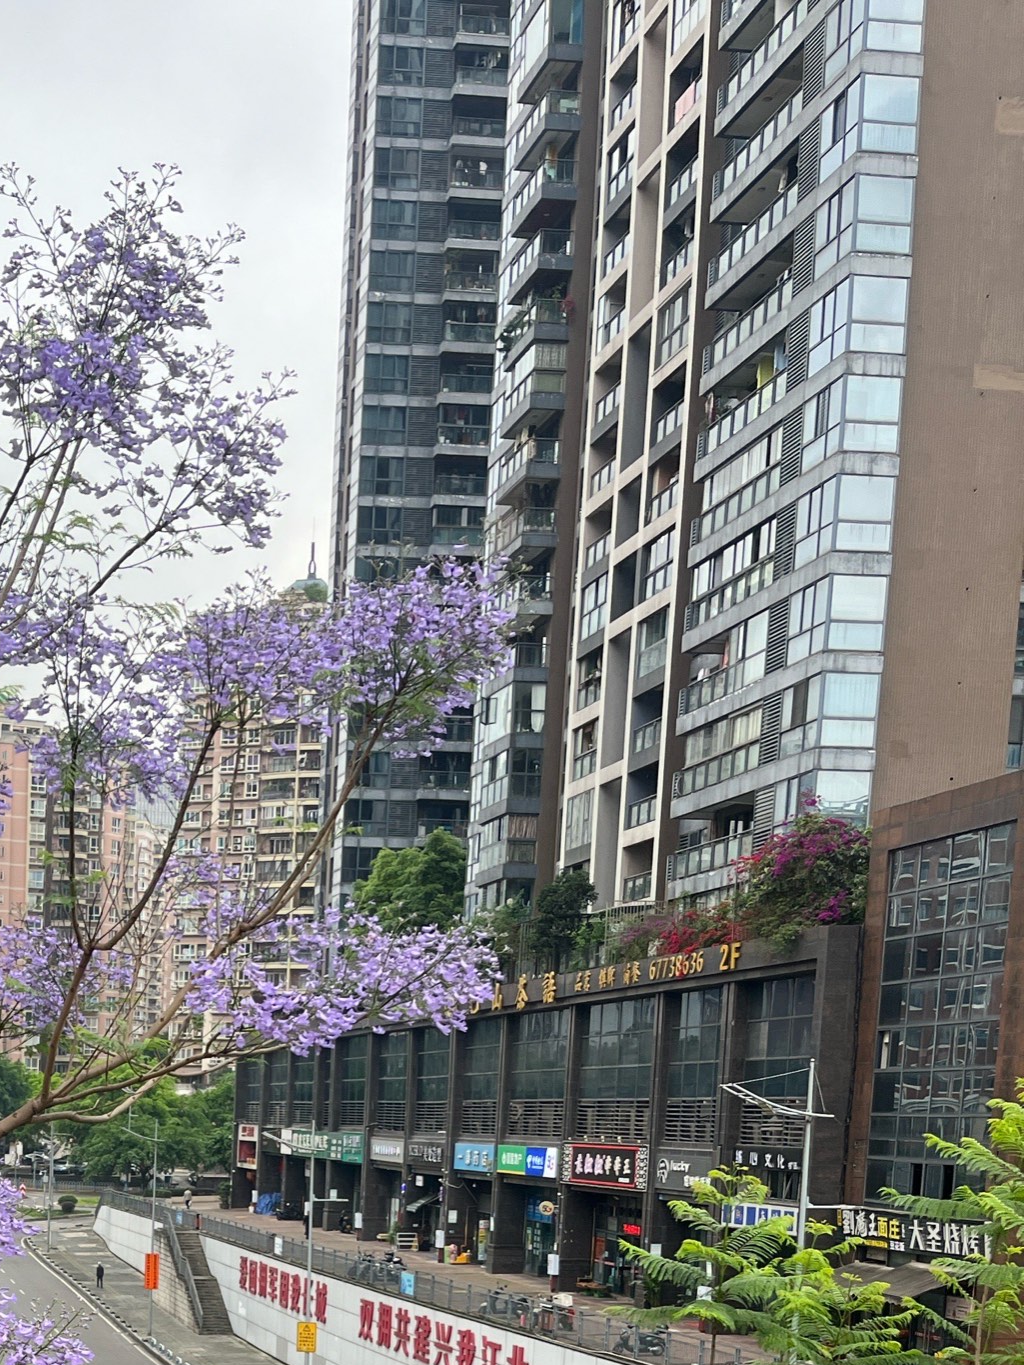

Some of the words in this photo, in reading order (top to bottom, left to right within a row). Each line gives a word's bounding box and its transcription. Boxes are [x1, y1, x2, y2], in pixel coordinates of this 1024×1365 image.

[648, 950, 704, 981] 67738636
[719, 941, 742, 971] 2F
[670, 1159, 691, 1173] lucky
[909, 1219, 980, 1257] 大圣烧烤
